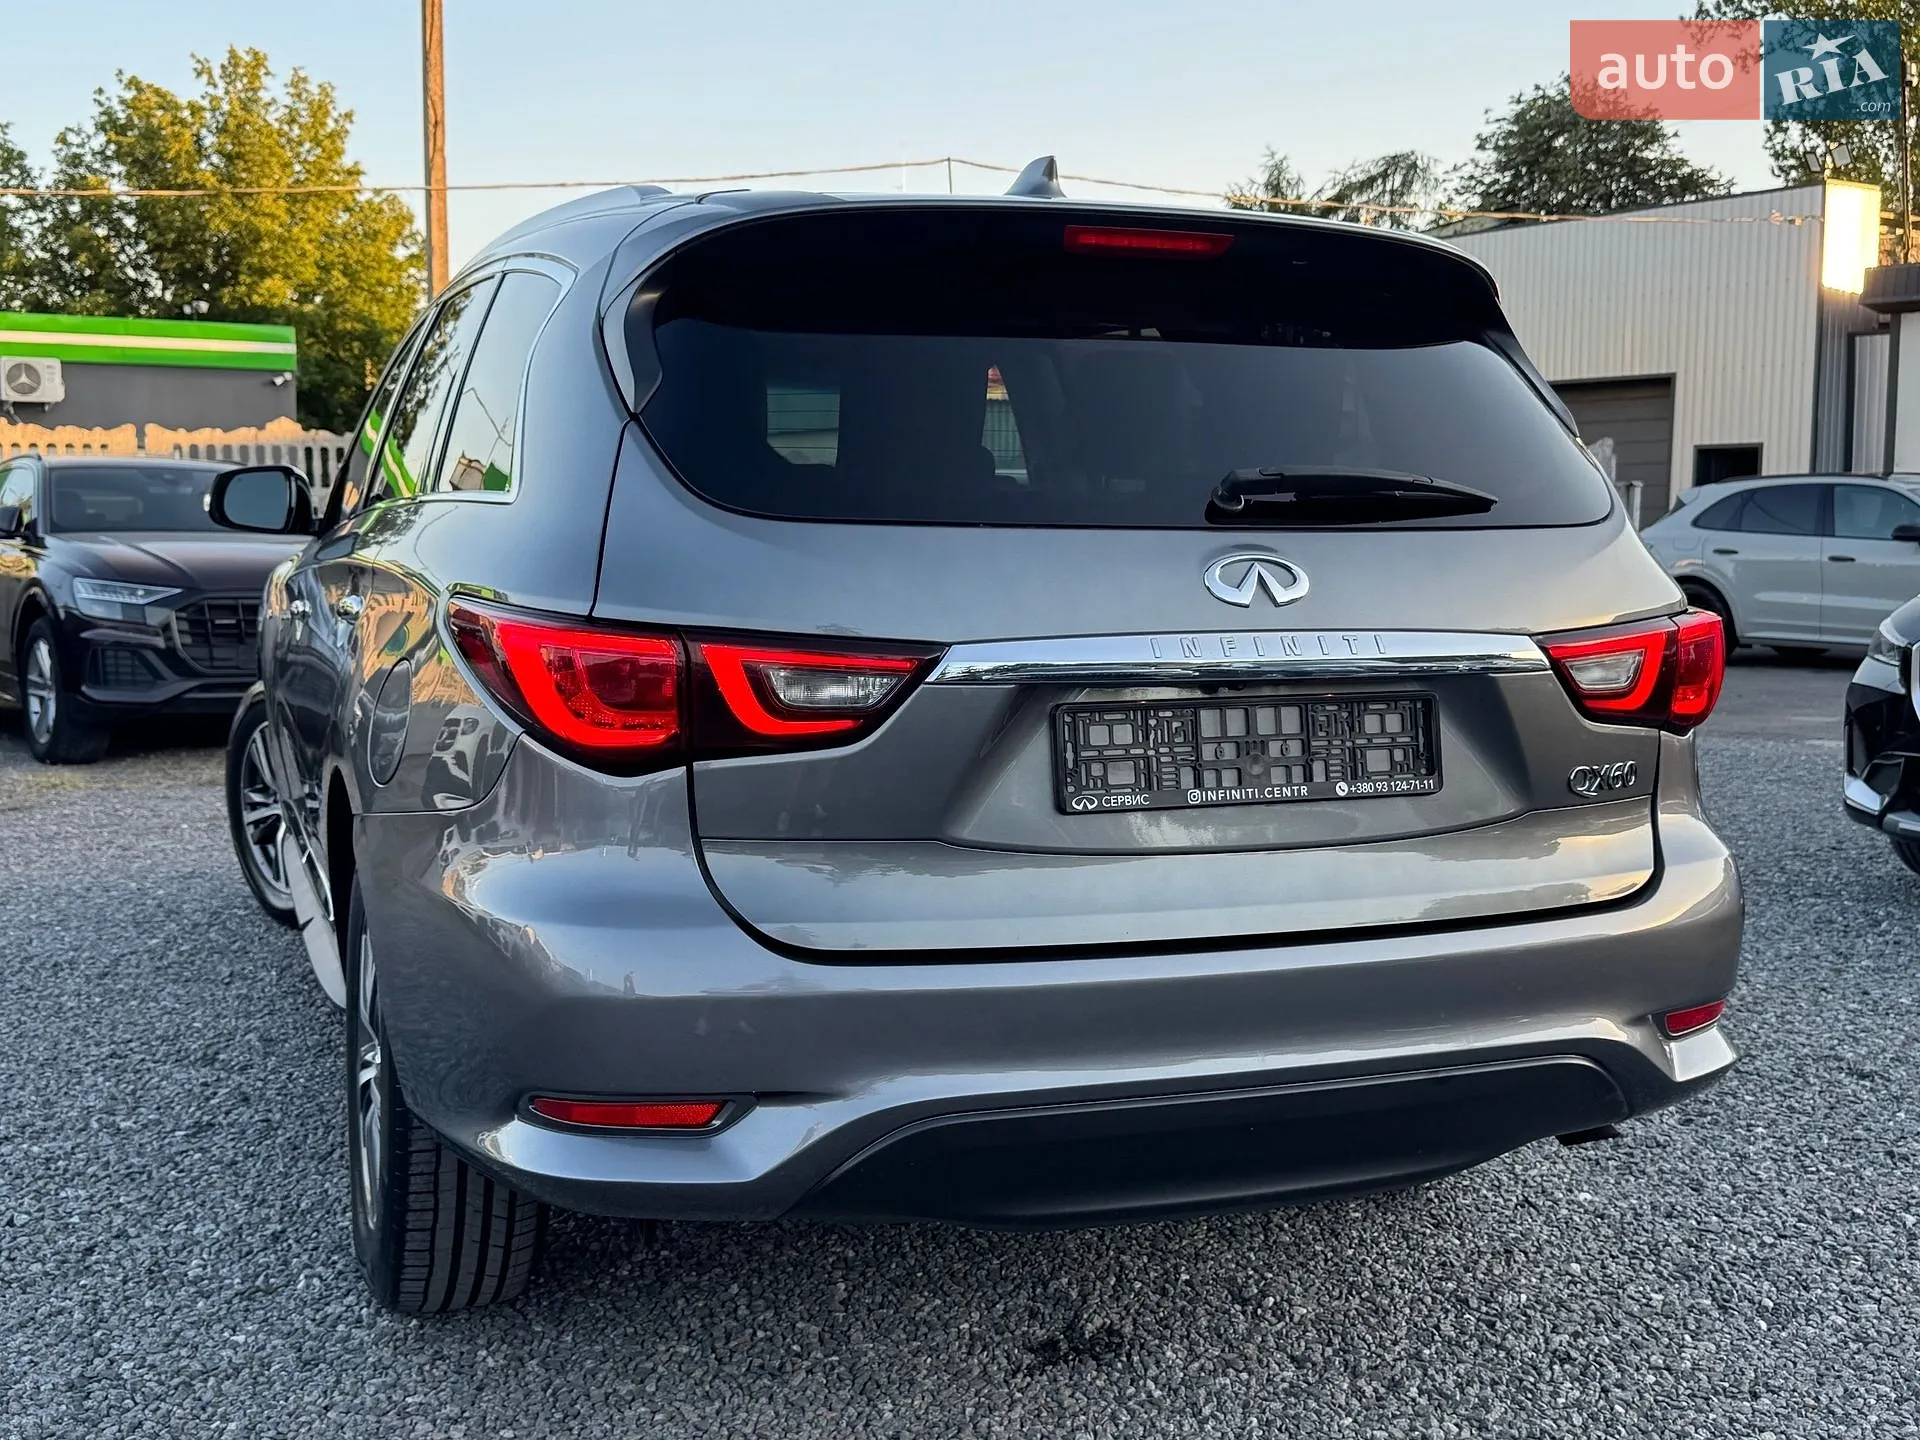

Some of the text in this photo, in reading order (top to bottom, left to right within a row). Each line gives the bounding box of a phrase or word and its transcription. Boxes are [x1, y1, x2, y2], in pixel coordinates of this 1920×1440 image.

[1150, 634, 1386, 659] INFINITI
[1350, 779, 1434, 794] +380 93 124-71-11
[1567, 760, 1637, 798] QX60
[1101, 794, 1150, 807] СЕРВИС
[1202, 785, 1309, 802] INFINITI.CENTR
